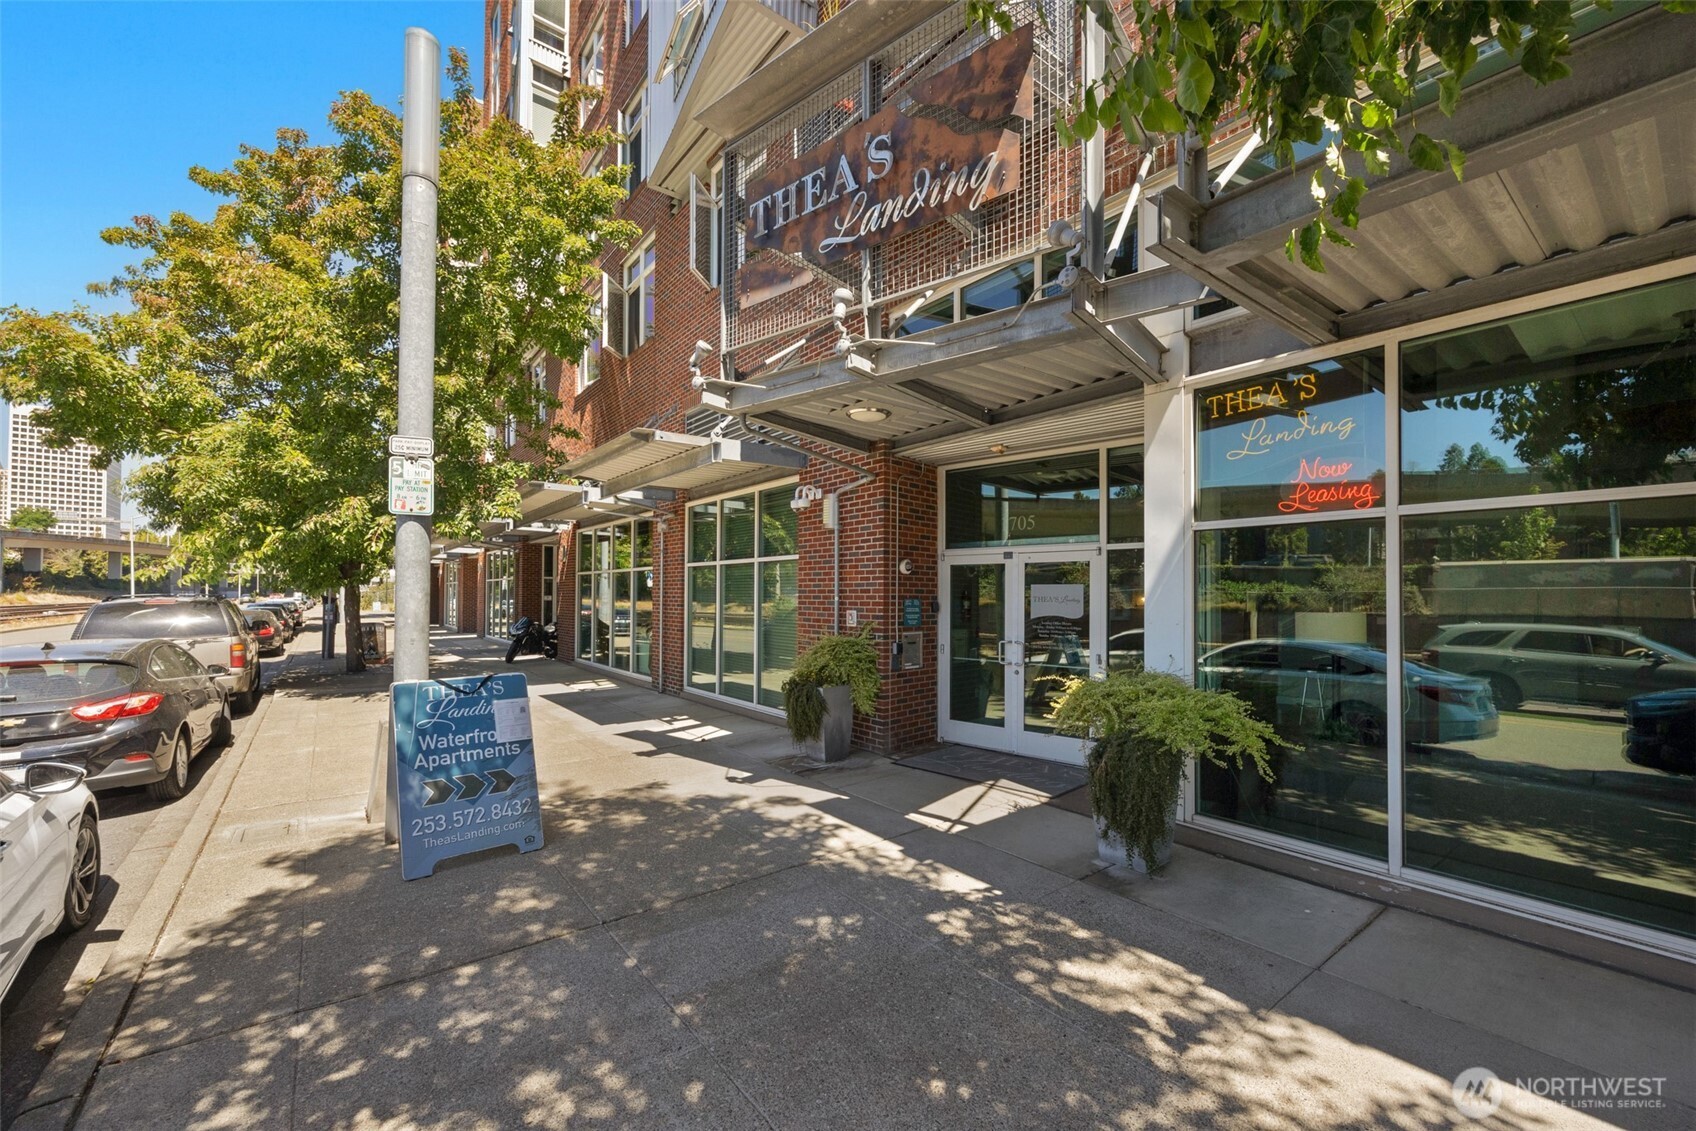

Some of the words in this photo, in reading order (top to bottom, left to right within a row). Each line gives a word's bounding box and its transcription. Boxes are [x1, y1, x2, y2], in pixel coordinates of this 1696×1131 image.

[750, 131, 894, 239] THEA'S
[819, 151, 999, 254] Landing
[1206, 373, 1317, 419] THEA'S
[1226, 410, 1356, 460] Landing
[392, 461, 402, 476] 5
[1290, 456, 1353, 483] Now
[1278, 479, 1381, 513] Leasing
[1009, 514, 1036, 531] 705
[422, 680, 505, 702] THEA'S
[414, 742, 521, 771] Apartments
[411, 798, 533, 836] 253.572.8432
[423, 819, 525, 849] TheasLanding.com
